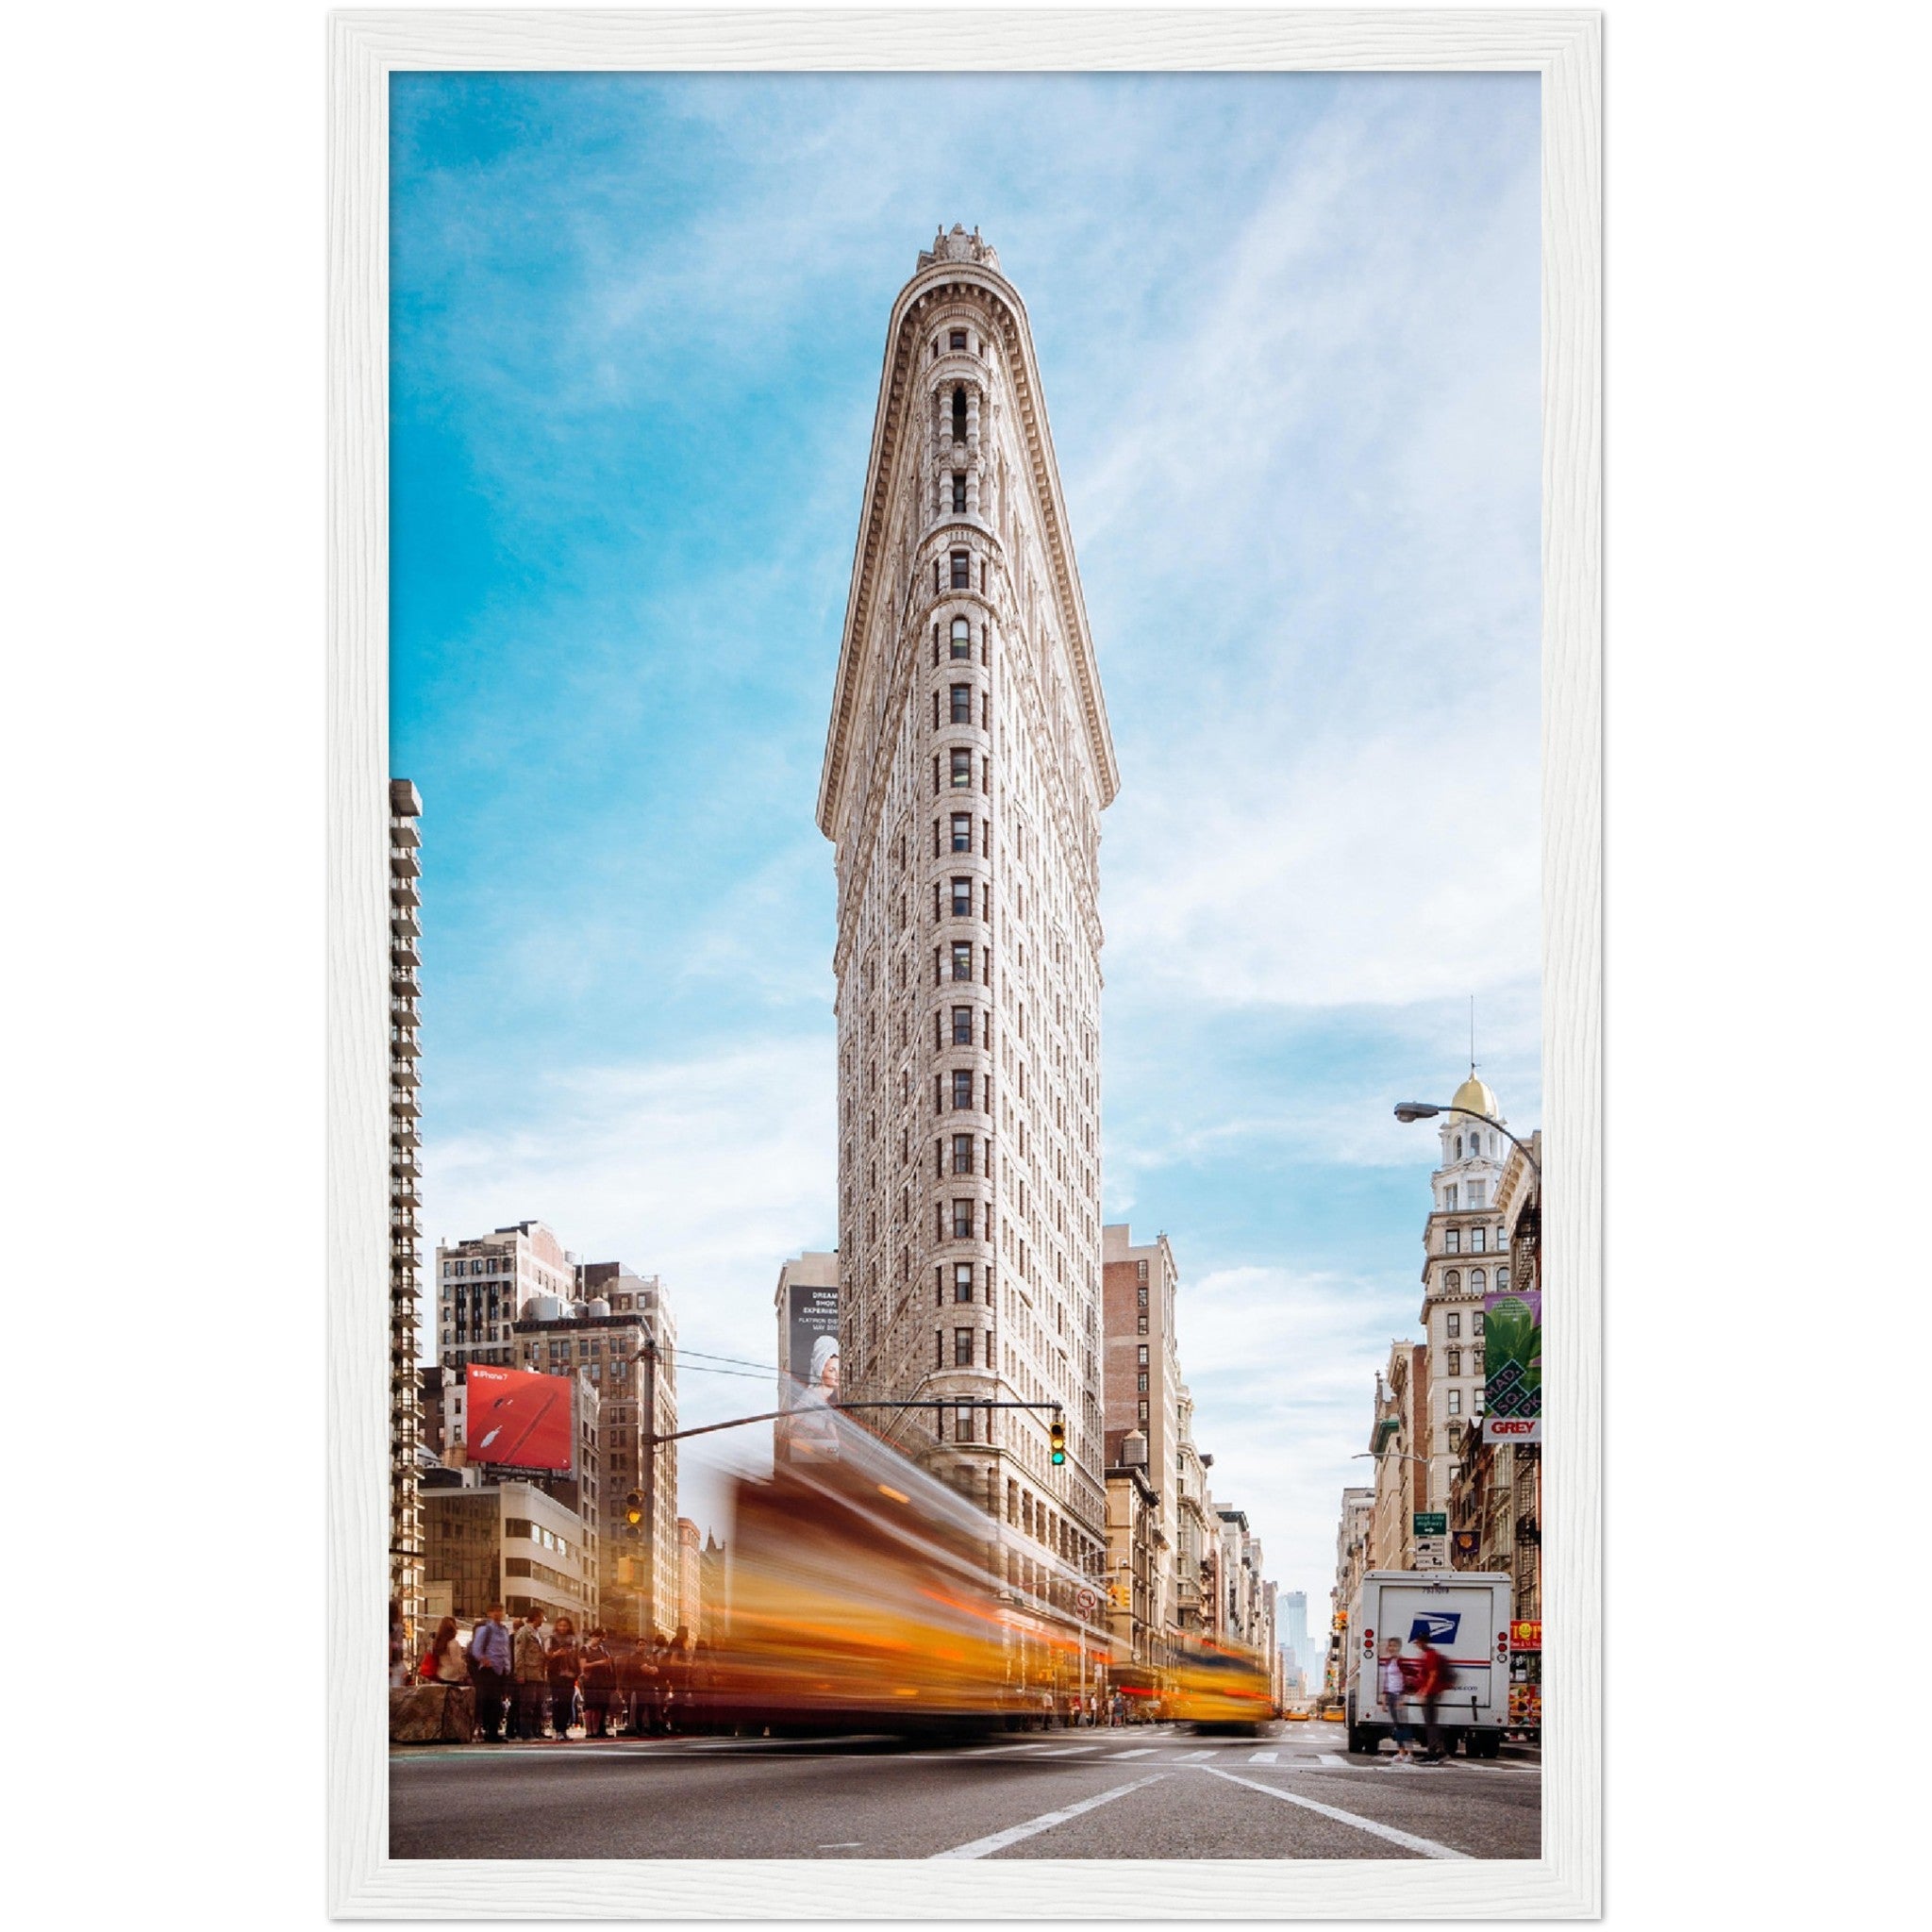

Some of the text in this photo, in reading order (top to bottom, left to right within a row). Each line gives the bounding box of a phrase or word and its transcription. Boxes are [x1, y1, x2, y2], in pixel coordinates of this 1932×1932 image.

[480, 1370, 503, 1380] iPhone
[1497, 1392, 1523, 1412] SQ.
[1491, 1421, 1536, 1434] GREY
